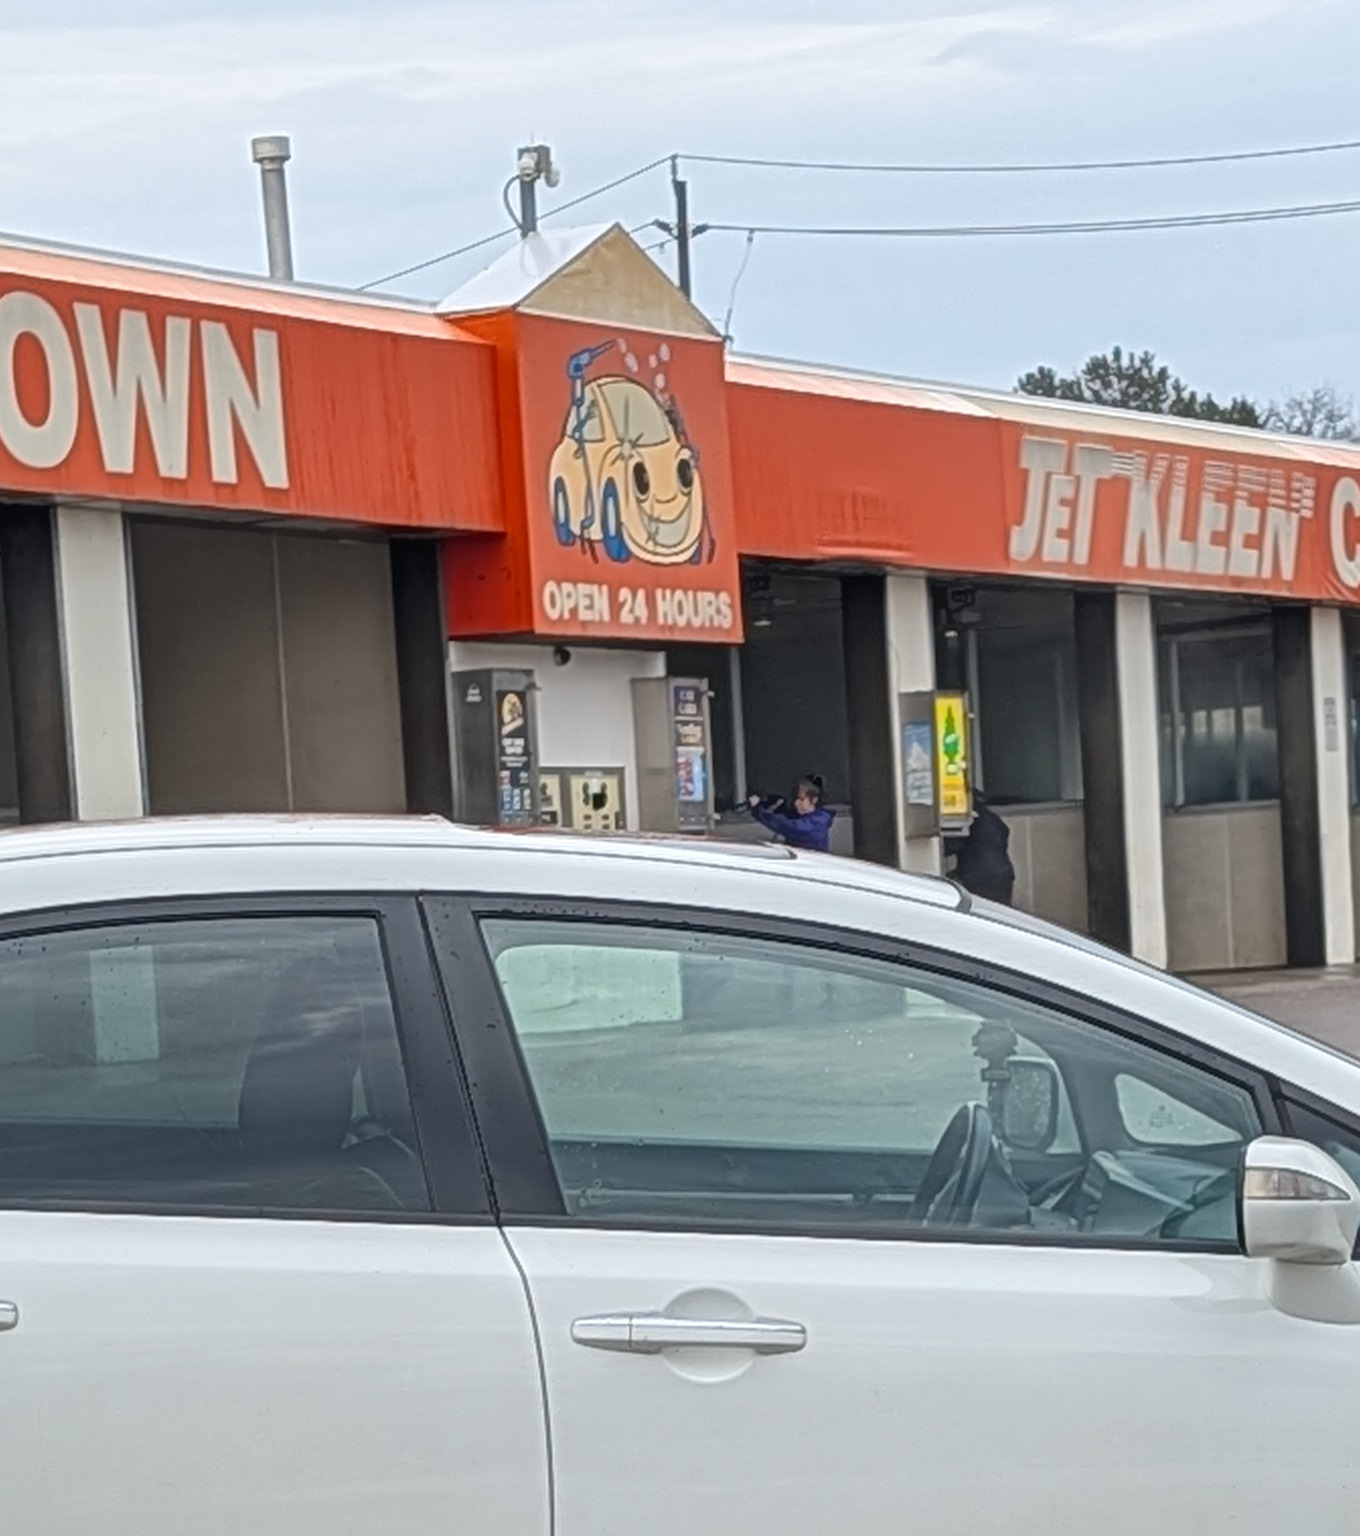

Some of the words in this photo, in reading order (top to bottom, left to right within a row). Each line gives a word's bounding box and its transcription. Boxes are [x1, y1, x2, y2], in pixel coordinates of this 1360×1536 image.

[1008, 435, 1114, 565] JET
[1115, 448, 1317, 582] KLEEN
[542, 581, 610, 624] OPEN
[618, 584, 648, 626] 24
[655, 586, 734, 630] HOURS
